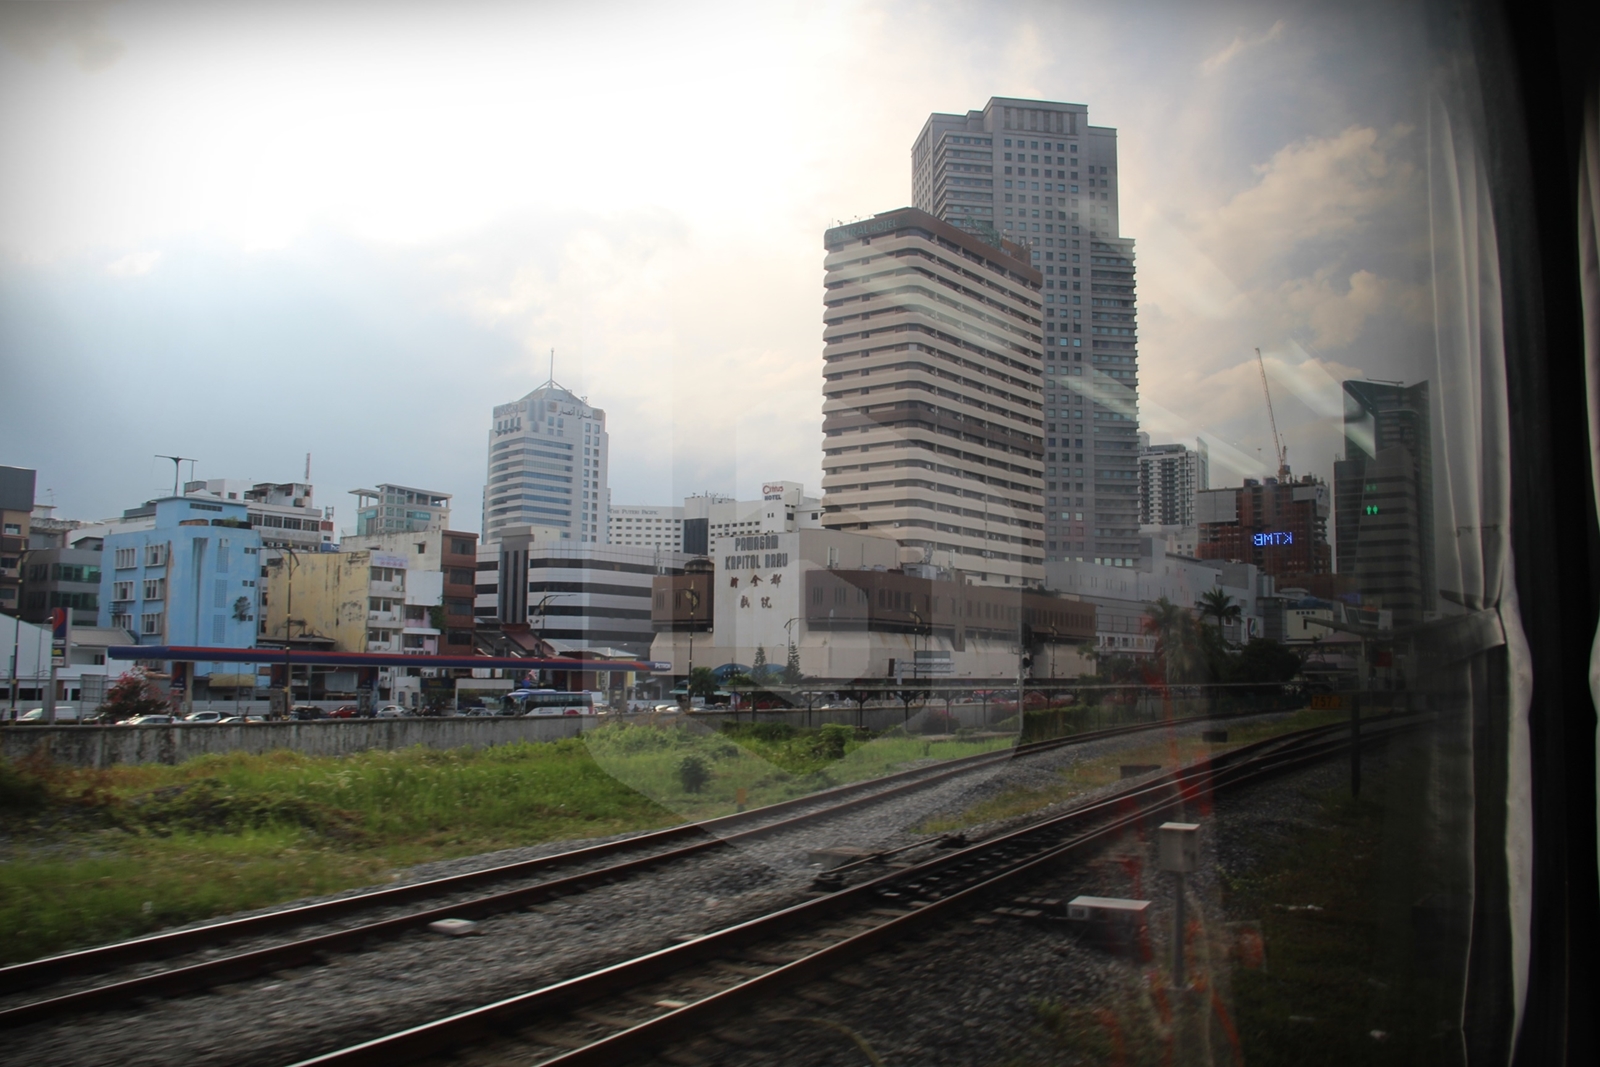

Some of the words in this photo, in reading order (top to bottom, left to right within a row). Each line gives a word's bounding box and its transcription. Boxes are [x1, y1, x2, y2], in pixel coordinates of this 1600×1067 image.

[825, 224, 869, 243] CENTRAL
[870, 219, 897, 231] HOTEL
[735, 535, 779, 551] PAWAGAM
[725, 555, 761, 570] KAPITOL
[764, 553, 788, 568] BARU
